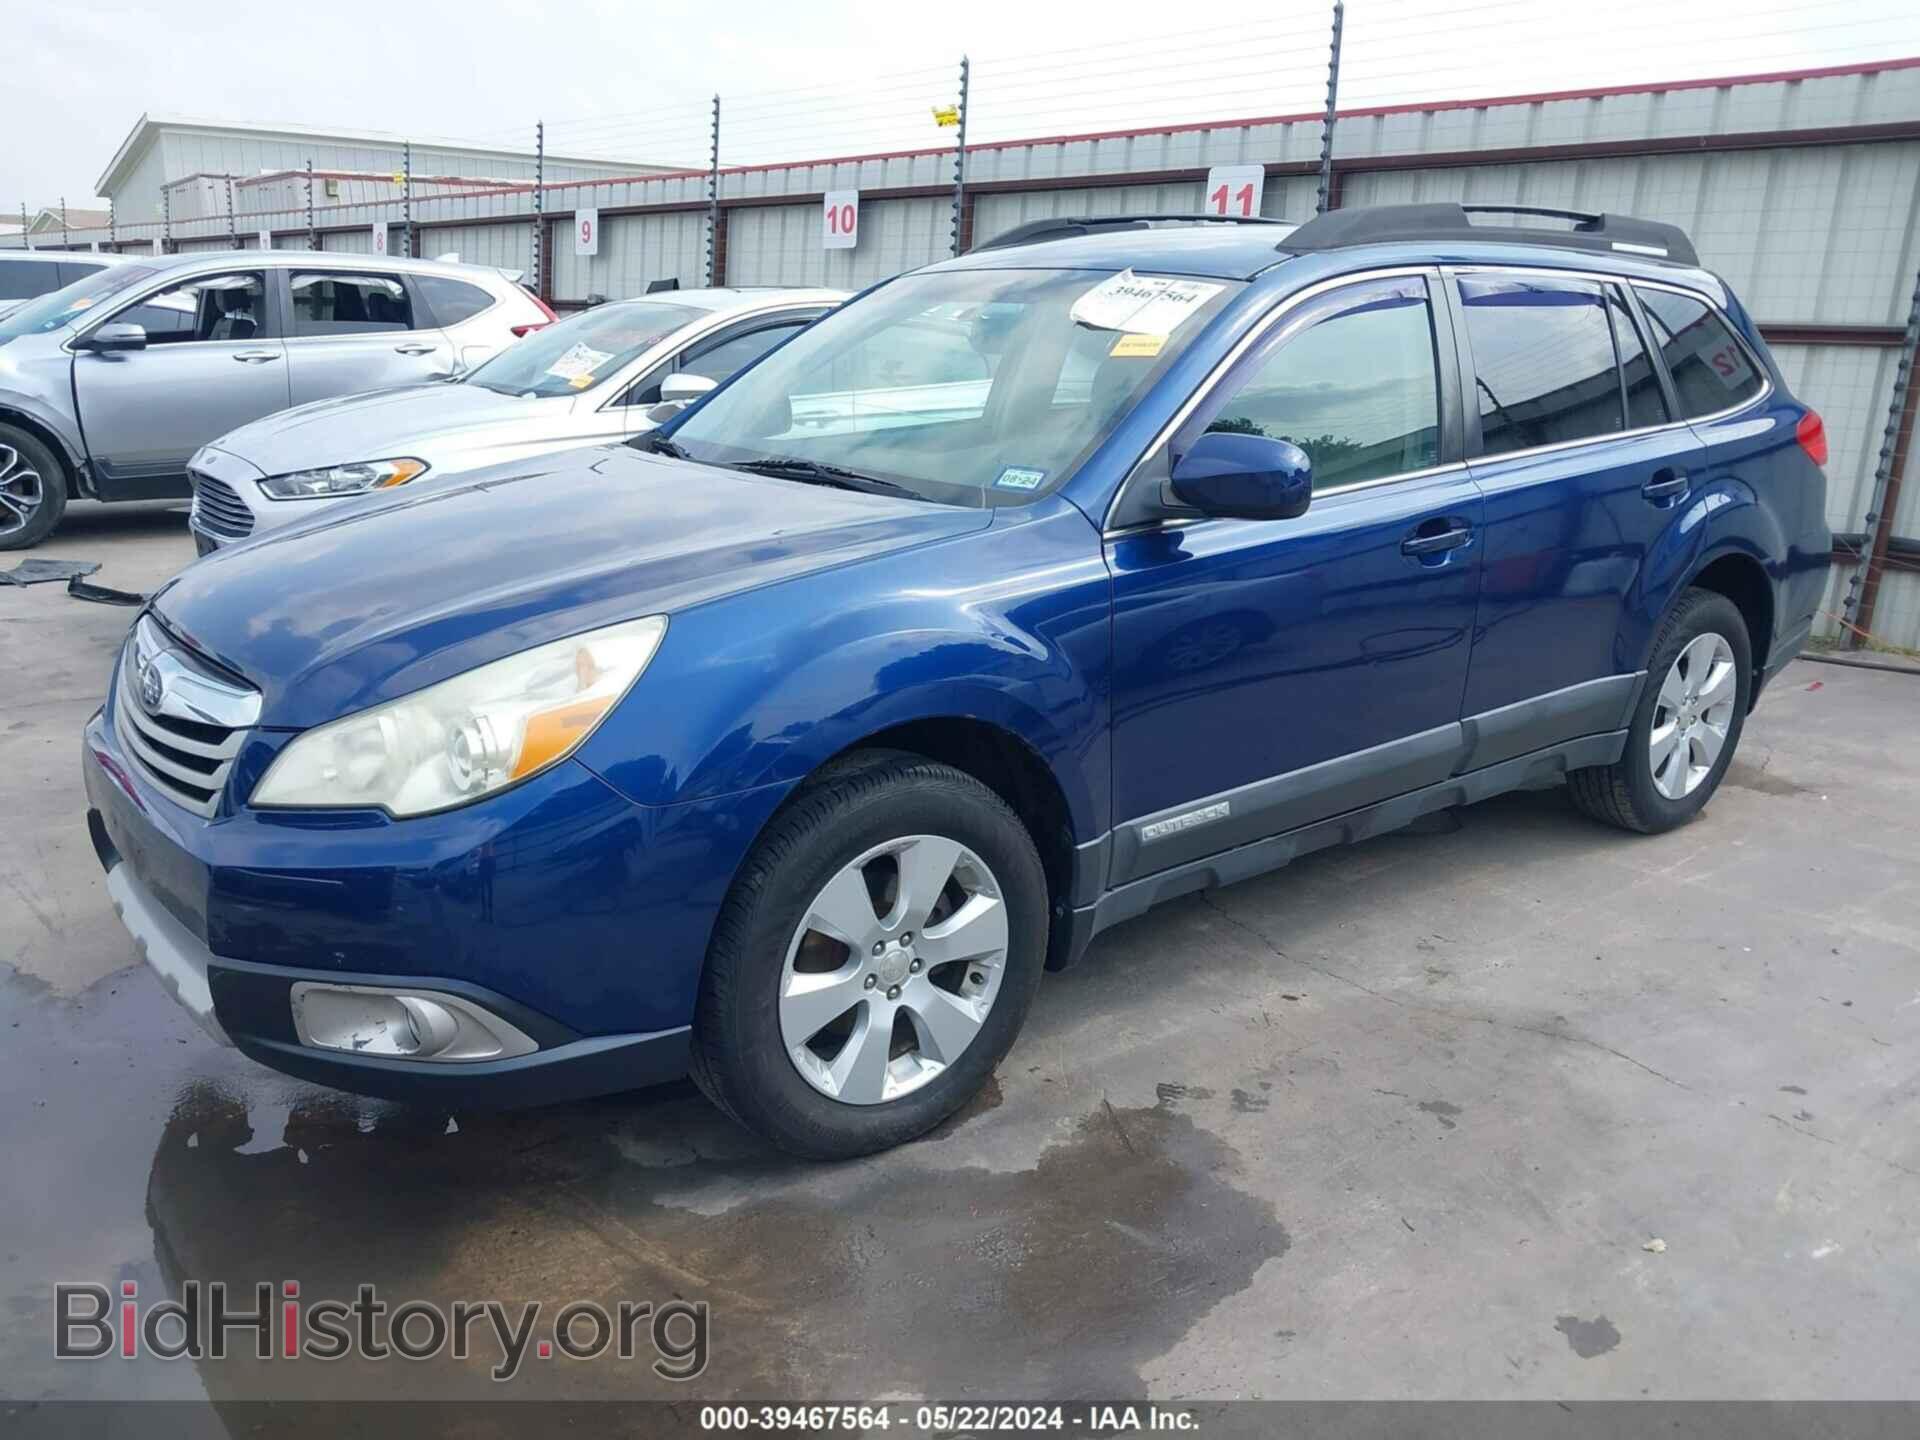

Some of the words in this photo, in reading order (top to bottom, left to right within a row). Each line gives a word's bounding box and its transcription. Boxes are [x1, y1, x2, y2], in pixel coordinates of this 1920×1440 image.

[1211, 183, 1253, 216] 11
[582, 220, 591, 244] 9
[827, 204, 855, 234] 10
[376, 231, 384, 251] 8
